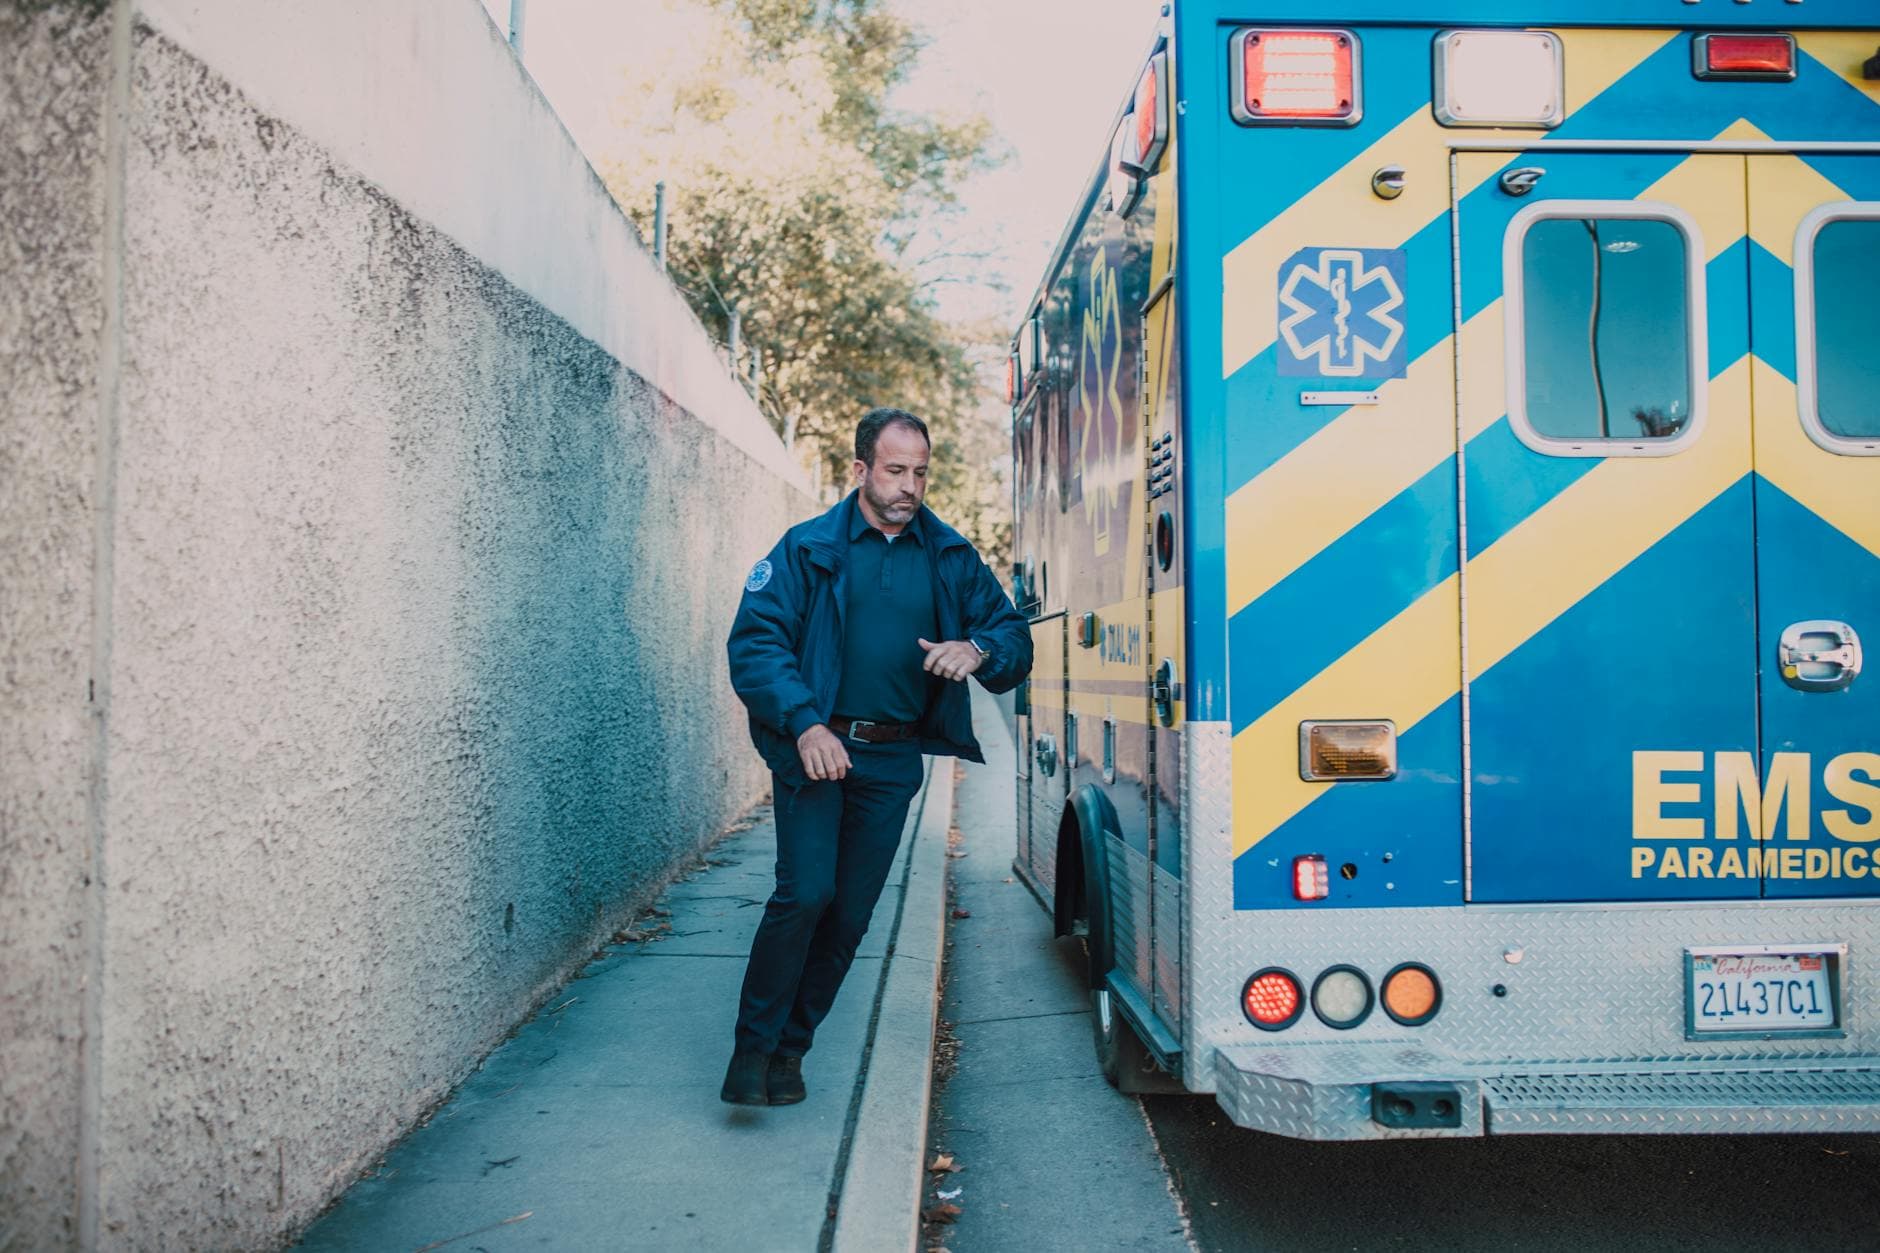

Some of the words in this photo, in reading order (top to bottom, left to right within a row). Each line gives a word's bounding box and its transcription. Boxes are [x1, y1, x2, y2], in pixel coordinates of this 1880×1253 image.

[1632, 750, 1880, 842] EMS
[1716, 959, 1796, 979] California
[1700, 980, 1823, 1017] 21437C1
